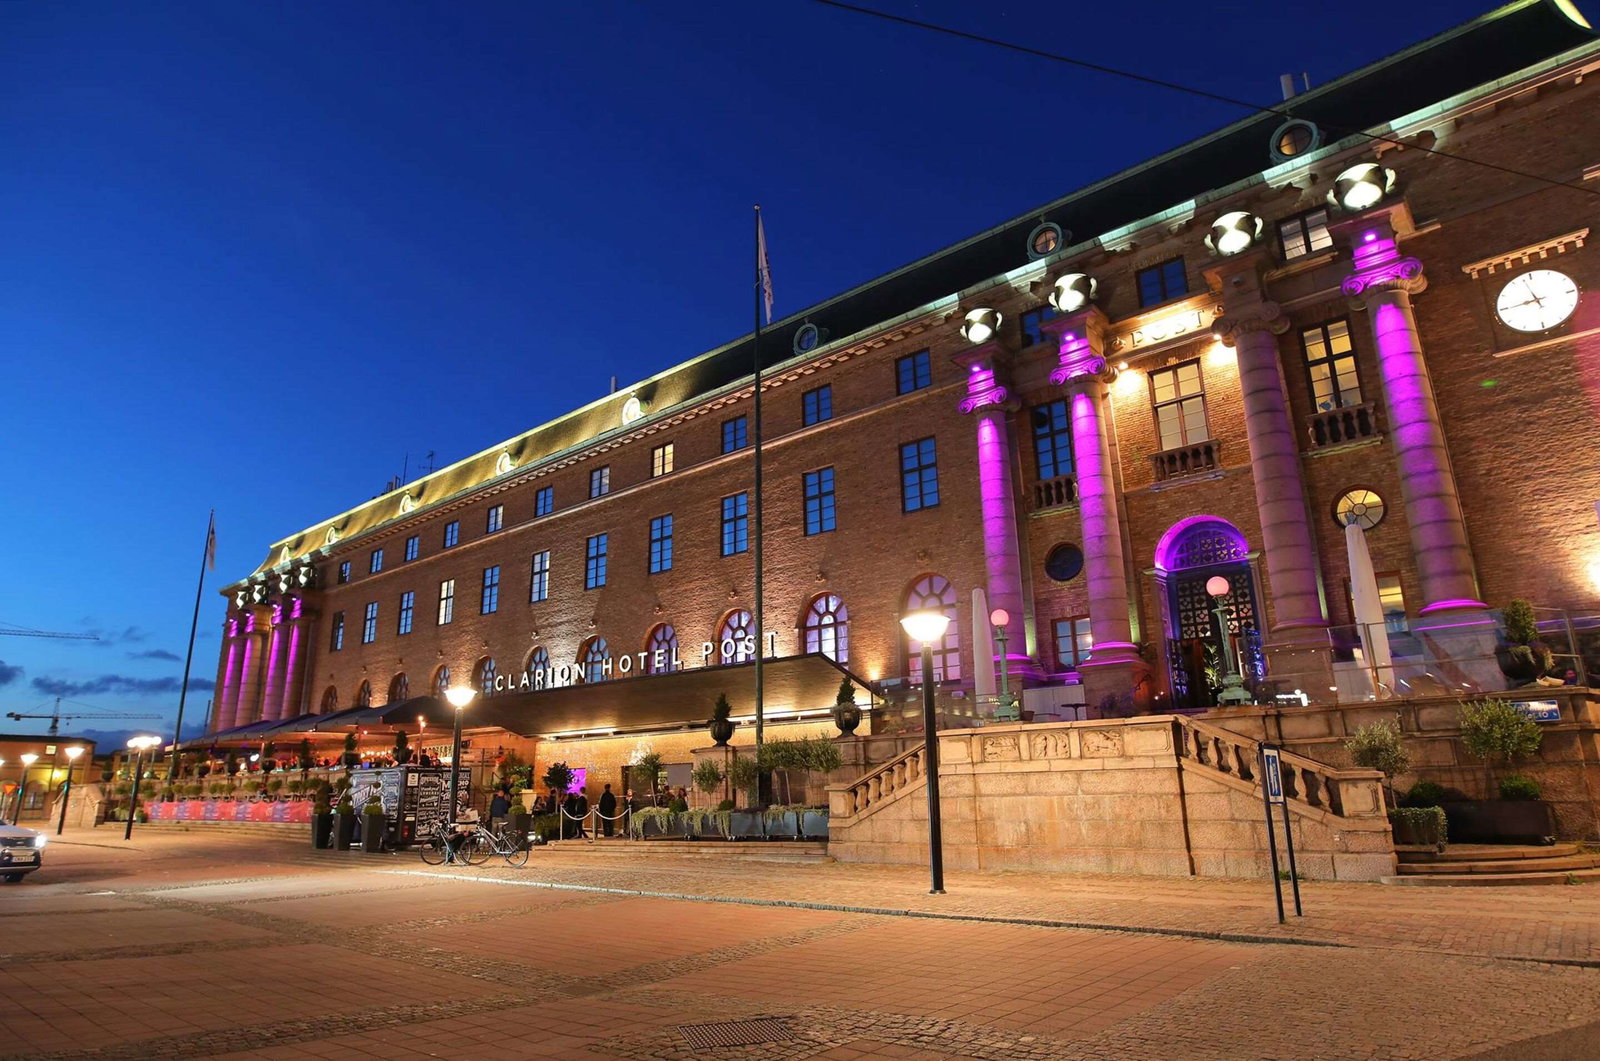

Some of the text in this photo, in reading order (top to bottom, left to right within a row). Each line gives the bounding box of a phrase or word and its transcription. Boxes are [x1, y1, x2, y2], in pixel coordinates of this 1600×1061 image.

[495, 631, 778, 691] CLARION HOTEL POST
